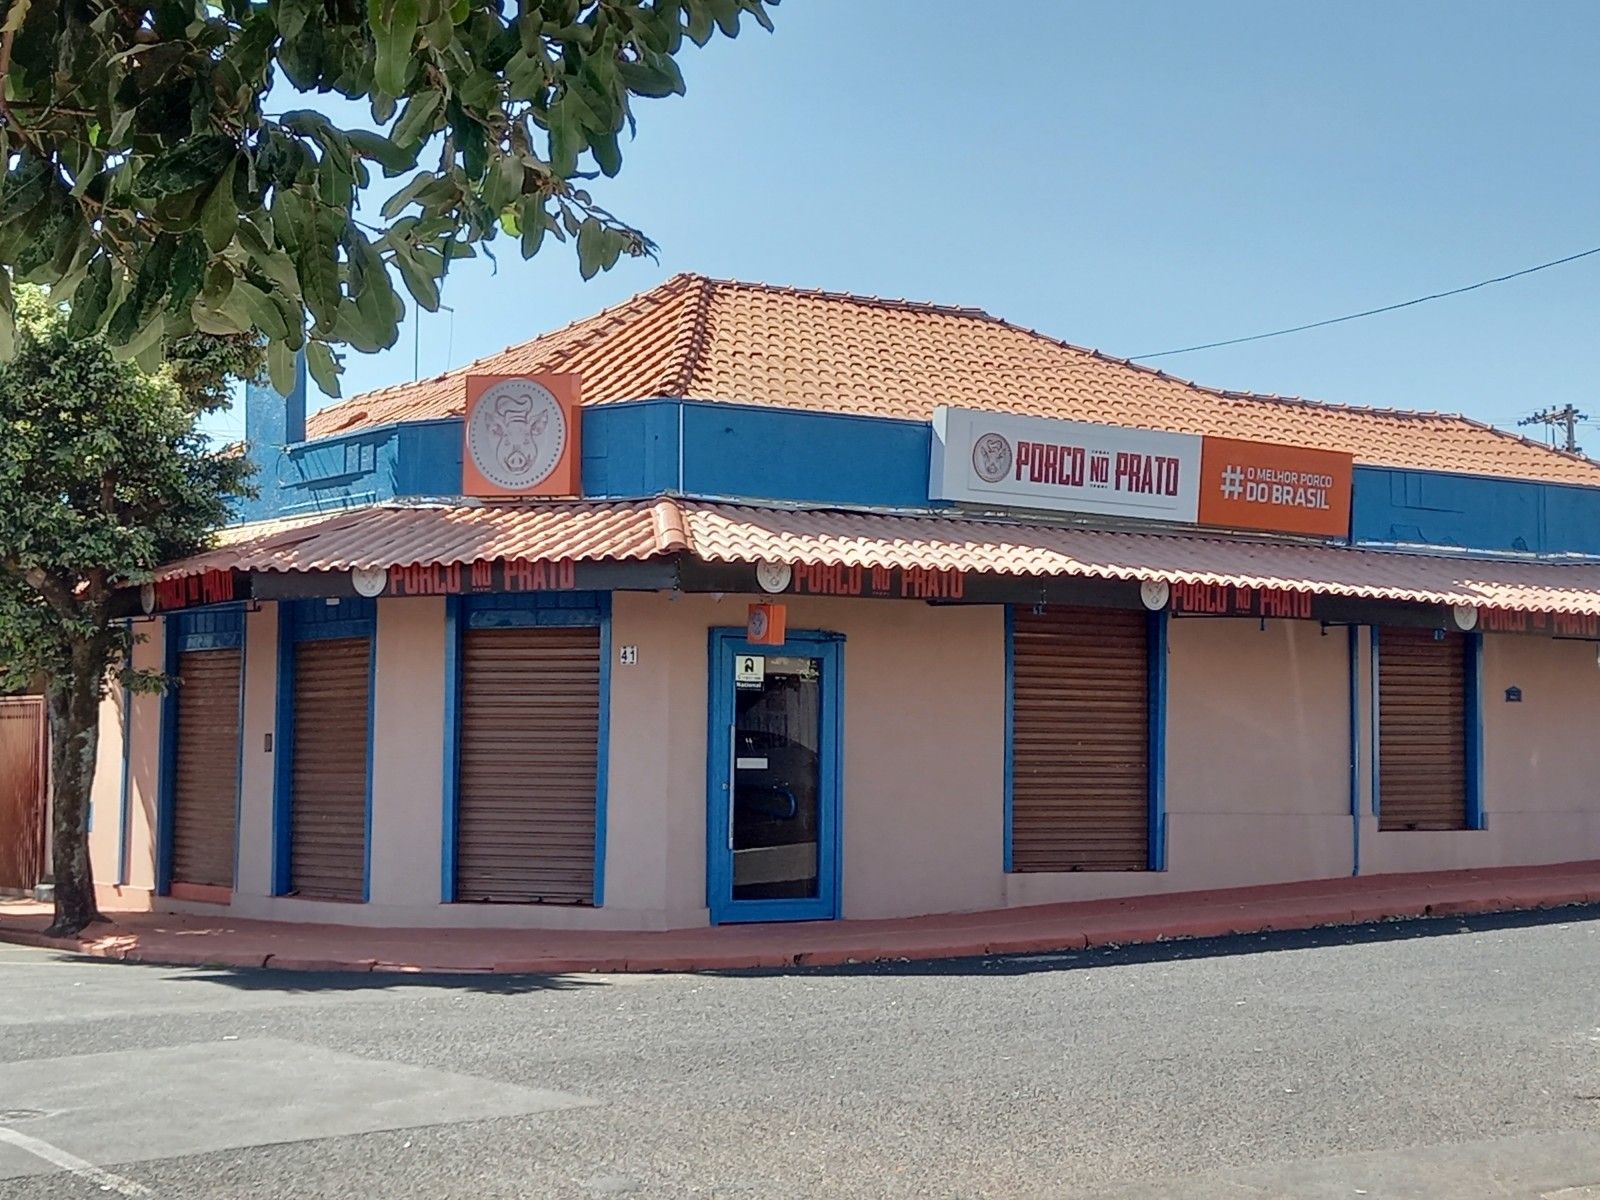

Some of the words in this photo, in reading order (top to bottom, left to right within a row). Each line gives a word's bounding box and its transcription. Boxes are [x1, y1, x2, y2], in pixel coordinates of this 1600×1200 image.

[1016, 441, 1086, 487] PORCO
[1090, 456, 1110, 483] NO
[1115, 452, 1180, 497] PRATO
[1256, 469, 1298, 484] MELHOR
[1300, 473, 1333, 488] PORCO
[1246, 482, 1269, 503] DO
[1271, 485, 1330, 510] BRASIL
[390, 561, 462, 594] PORCO
[503, 558, 575, 591] PRATO
[793, 561, 862, 594] PORCO
[901, 563, 965, 598] PRATO
[1171, 580, 1227, 613] PORCO
[1259, 587, 1312, 618] PRATO
[621, 649, 635, 661] 41
